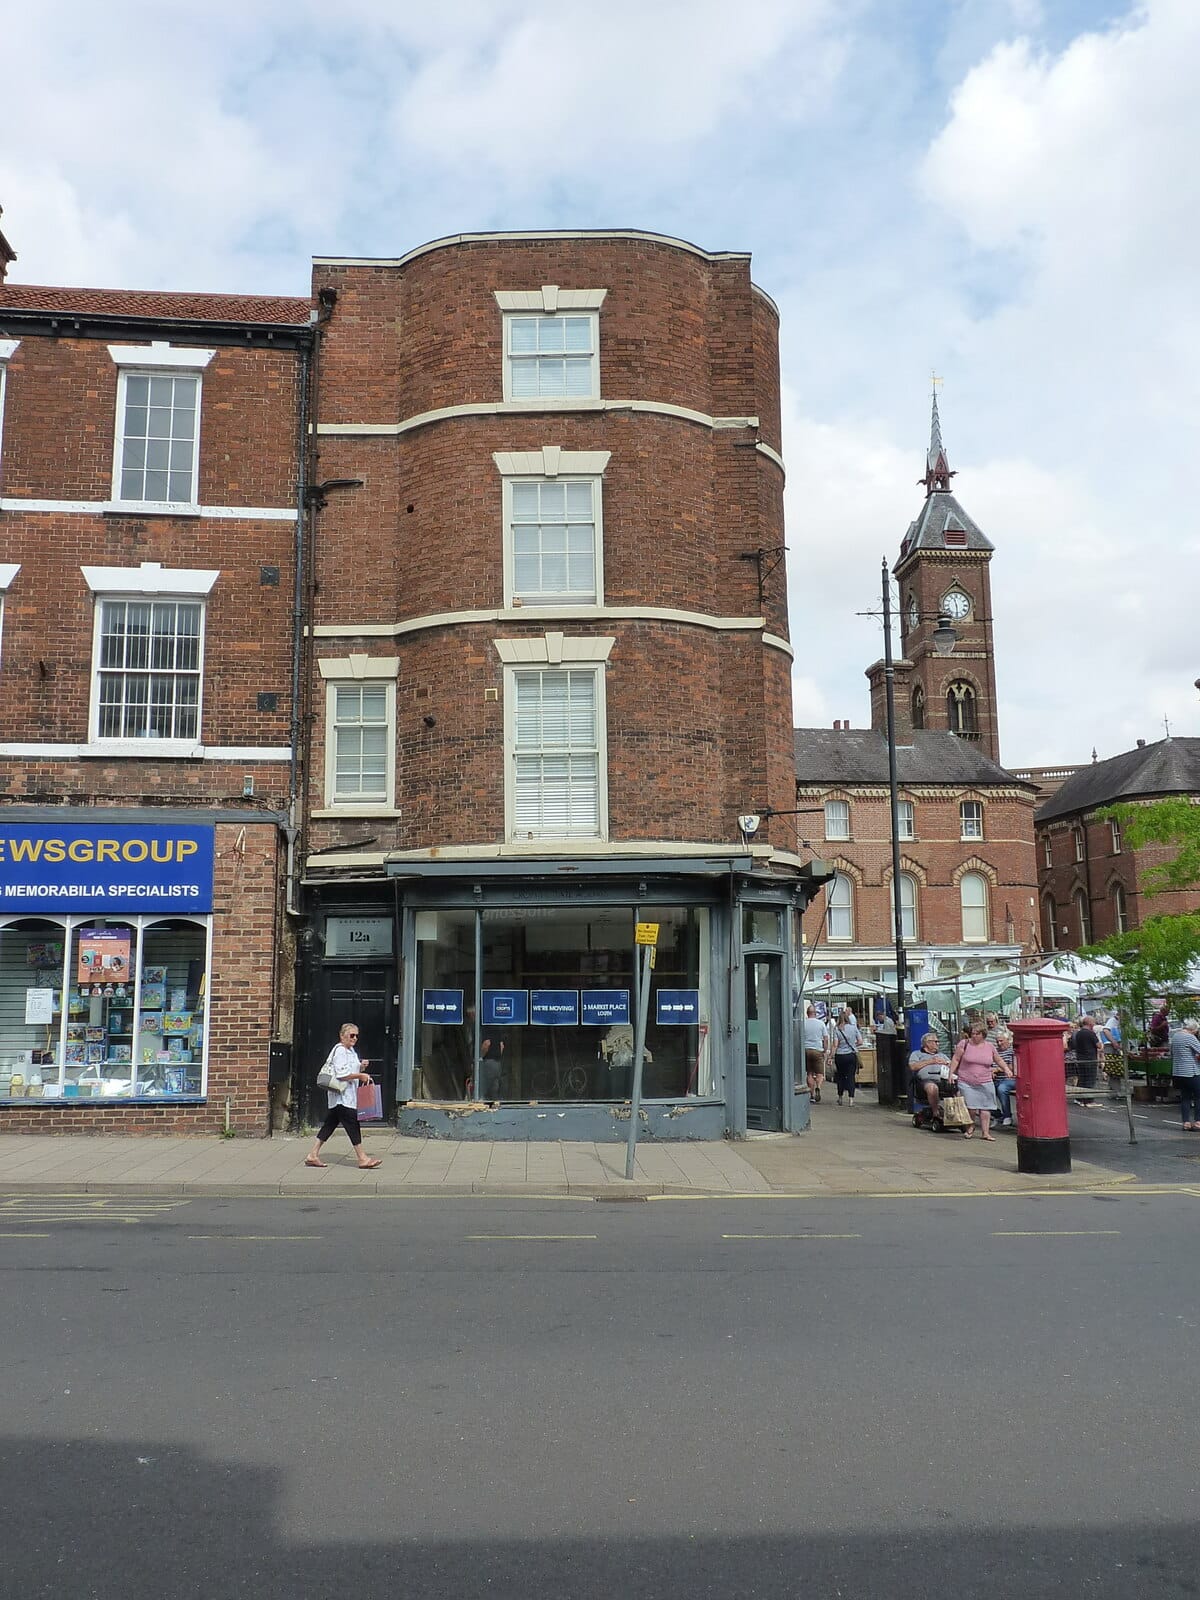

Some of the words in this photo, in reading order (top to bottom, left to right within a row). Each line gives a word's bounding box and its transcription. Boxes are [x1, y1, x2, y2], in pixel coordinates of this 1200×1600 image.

[0, 839, 198, 862] WSGROUP
[5, 885, 105, 897] MEMORABILIA
[108, 885, 200, 897] SPECIALISTS
